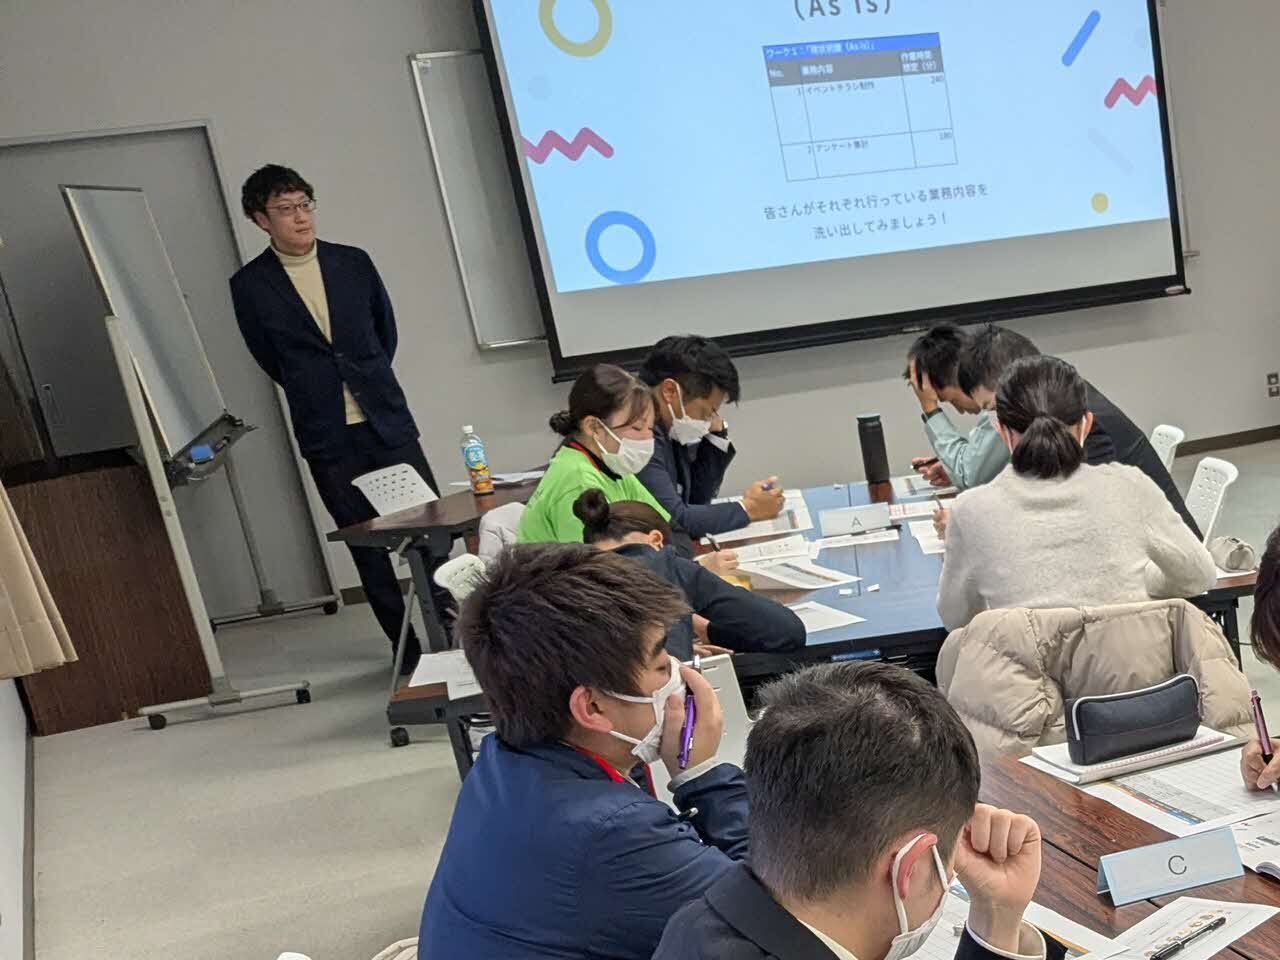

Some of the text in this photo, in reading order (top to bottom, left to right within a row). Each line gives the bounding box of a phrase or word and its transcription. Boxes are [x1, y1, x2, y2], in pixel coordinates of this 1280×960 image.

[763, 183, 988, 220] 皆さんがそれぞれ行っている業務内容を
[812, 212, 947, 240] 洗い出してみましょう！
[851, 515, 863, 528] A
[1168, 854, 1187, 876] C
